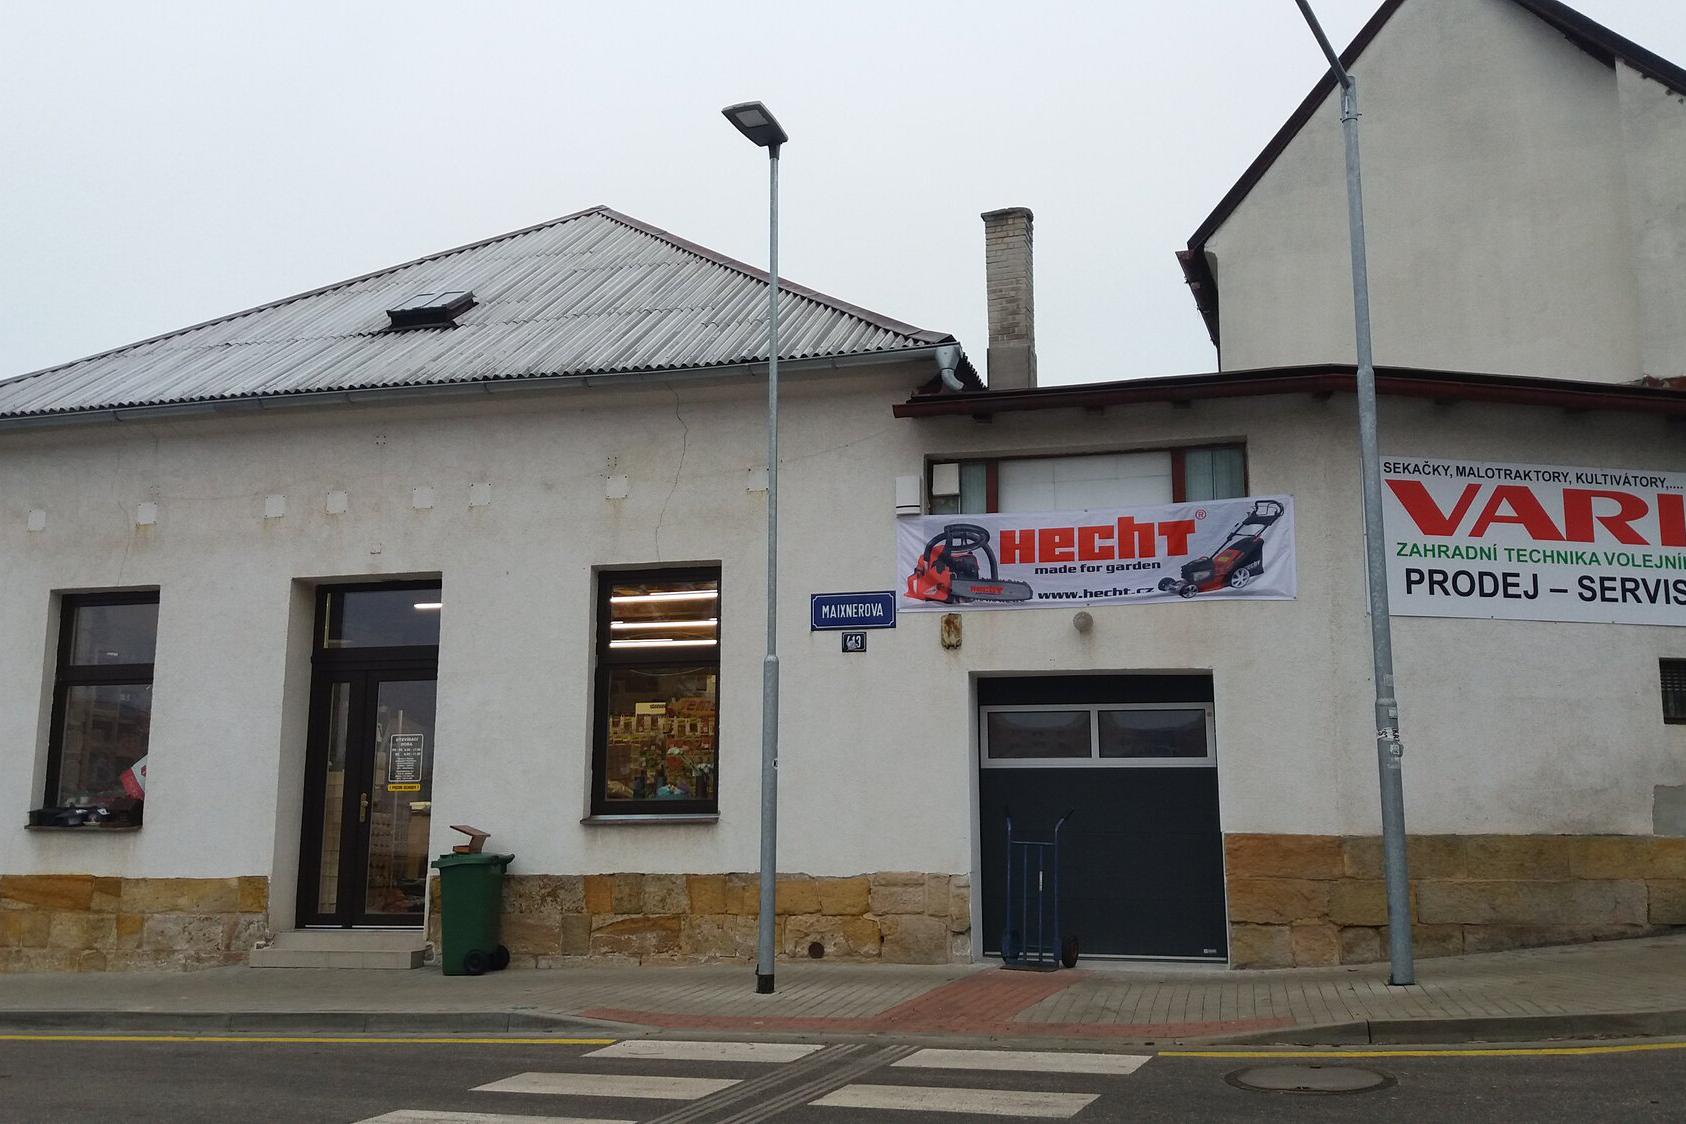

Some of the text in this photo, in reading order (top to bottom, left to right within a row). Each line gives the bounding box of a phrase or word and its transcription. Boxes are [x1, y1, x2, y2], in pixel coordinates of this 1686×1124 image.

[1383, 461, 1453, 479] SEKAČKY,
[1456, 465, 1573, 486] MALOTRAKTORY,
[1384, 479, 1686, 548] VARI
[1034, 561, 1161, 575] made for garden
[1396, 542, 1686, 571] ZAHRADNÍ TECHNIKA VOLEJNÍ
[1038, 587, 1155, 600] www.hecht.cz
[1405, 567, 1539, 600] PRODEJ
[1577, 575, 1686, 606] SERVIS
[822, 603, 884, 619] MAIXNEROVA
